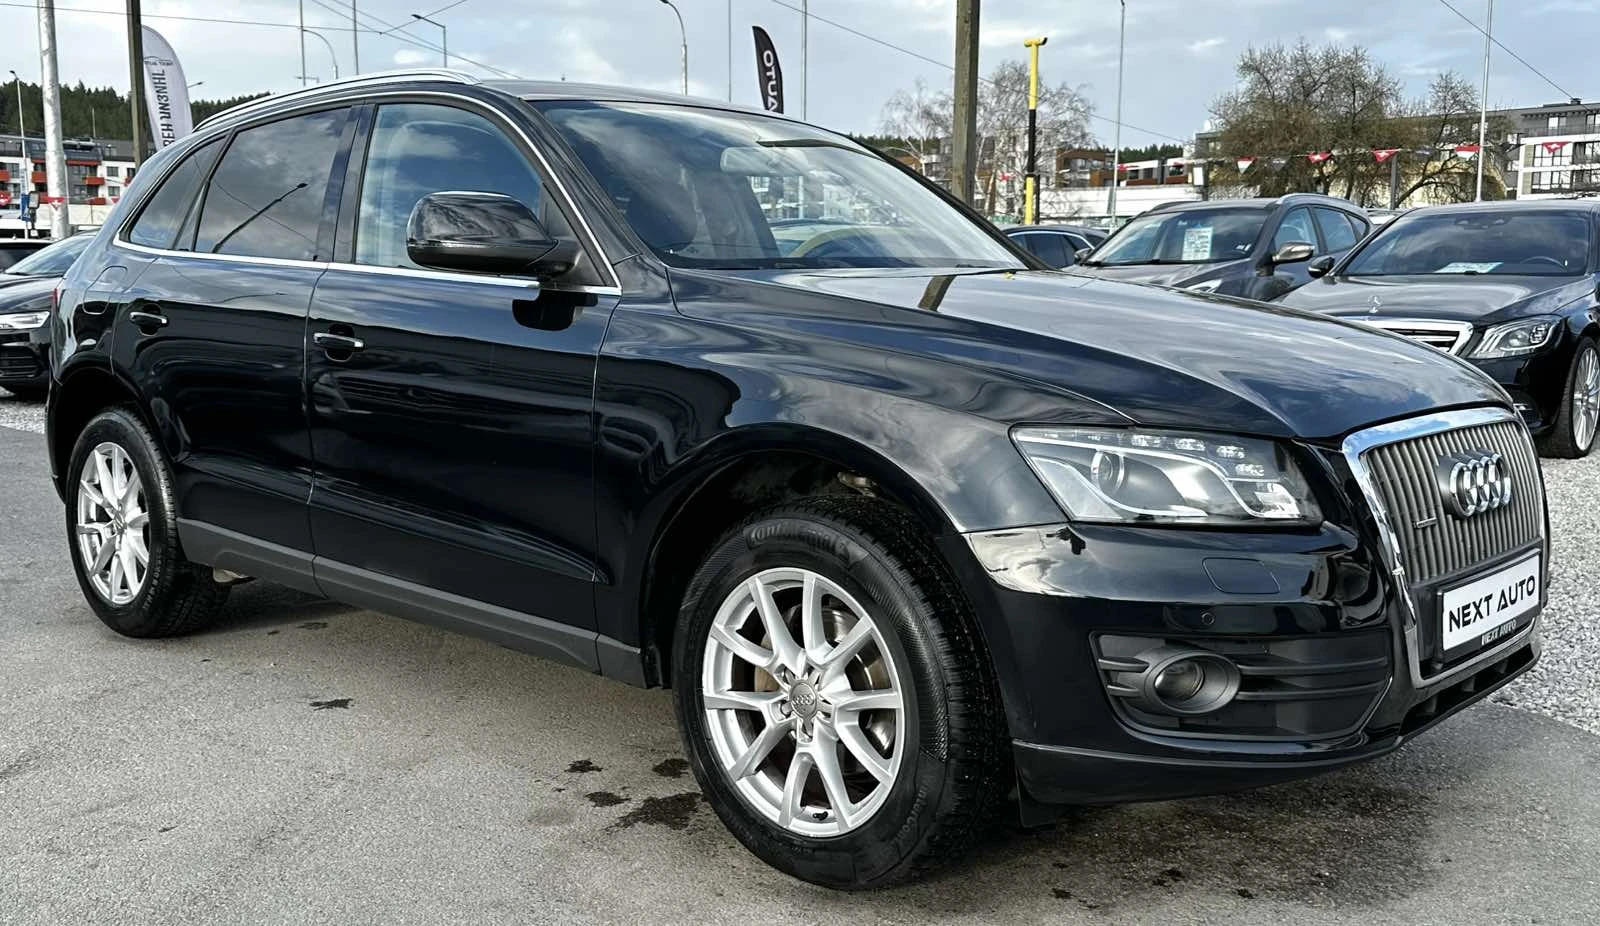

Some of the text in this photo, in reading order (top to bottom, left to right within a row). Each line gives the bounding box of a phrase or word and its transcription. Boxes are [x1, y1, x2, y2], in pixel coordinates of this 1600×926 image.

[1449, 575, 1536, 633] NEXT AUTO
[1481, 619, 1517, 646] NEXT AUTO
